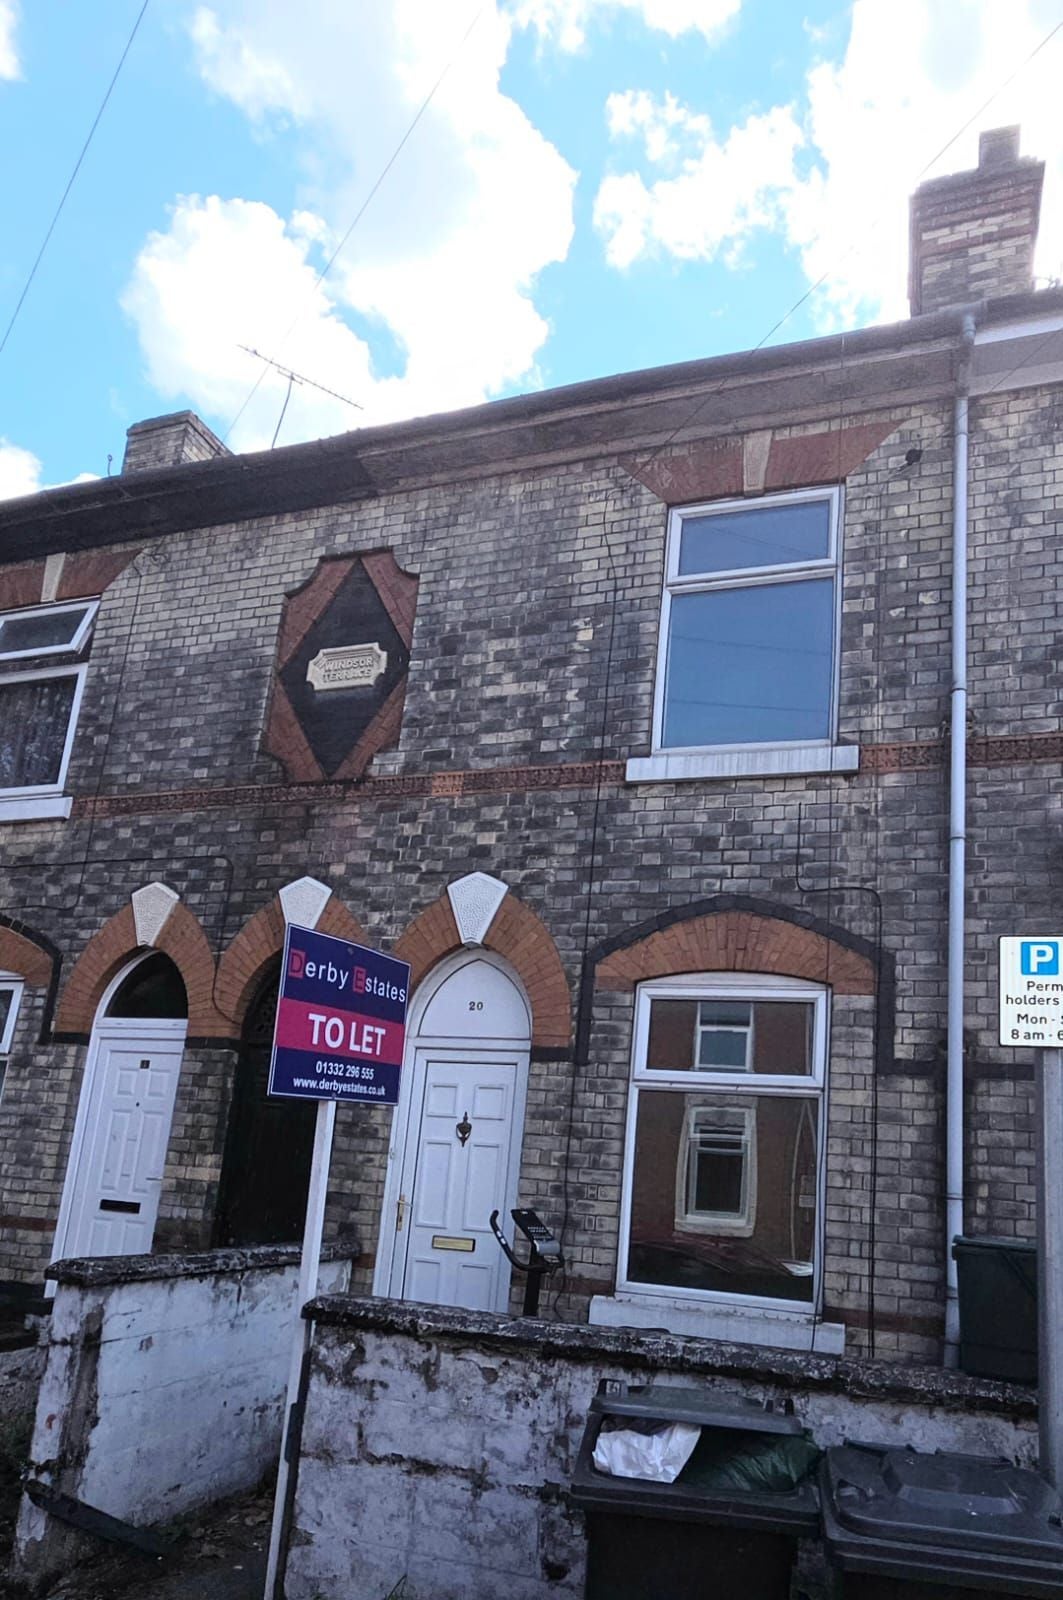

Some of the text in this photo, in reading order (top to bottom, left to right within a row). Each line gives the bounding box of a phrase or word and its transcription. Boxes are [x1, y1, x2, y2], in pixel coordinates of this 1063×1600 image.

[325, 657, 374, 672] WINDSOR
[323, 667, 372, 682] TERRACE
[1029, 944, 1054, 973] P
[288, 949, 406, 1002] Derby Estates
[468, 1001, 484, 1011] 20
[1006, 994, 1060, 1006] holders
[1016, 1013, 1047, 1024] Mon
[308, 1012, 386, 1056] TO LET
[1011, 1029, 1019, 1040] 8
[1023, 1031, 1044, 1040] am
[315, 1060, 375, 1080] 01332 296 555
[293, 1076, 386, 1096] www.derbyestates.co.uk
